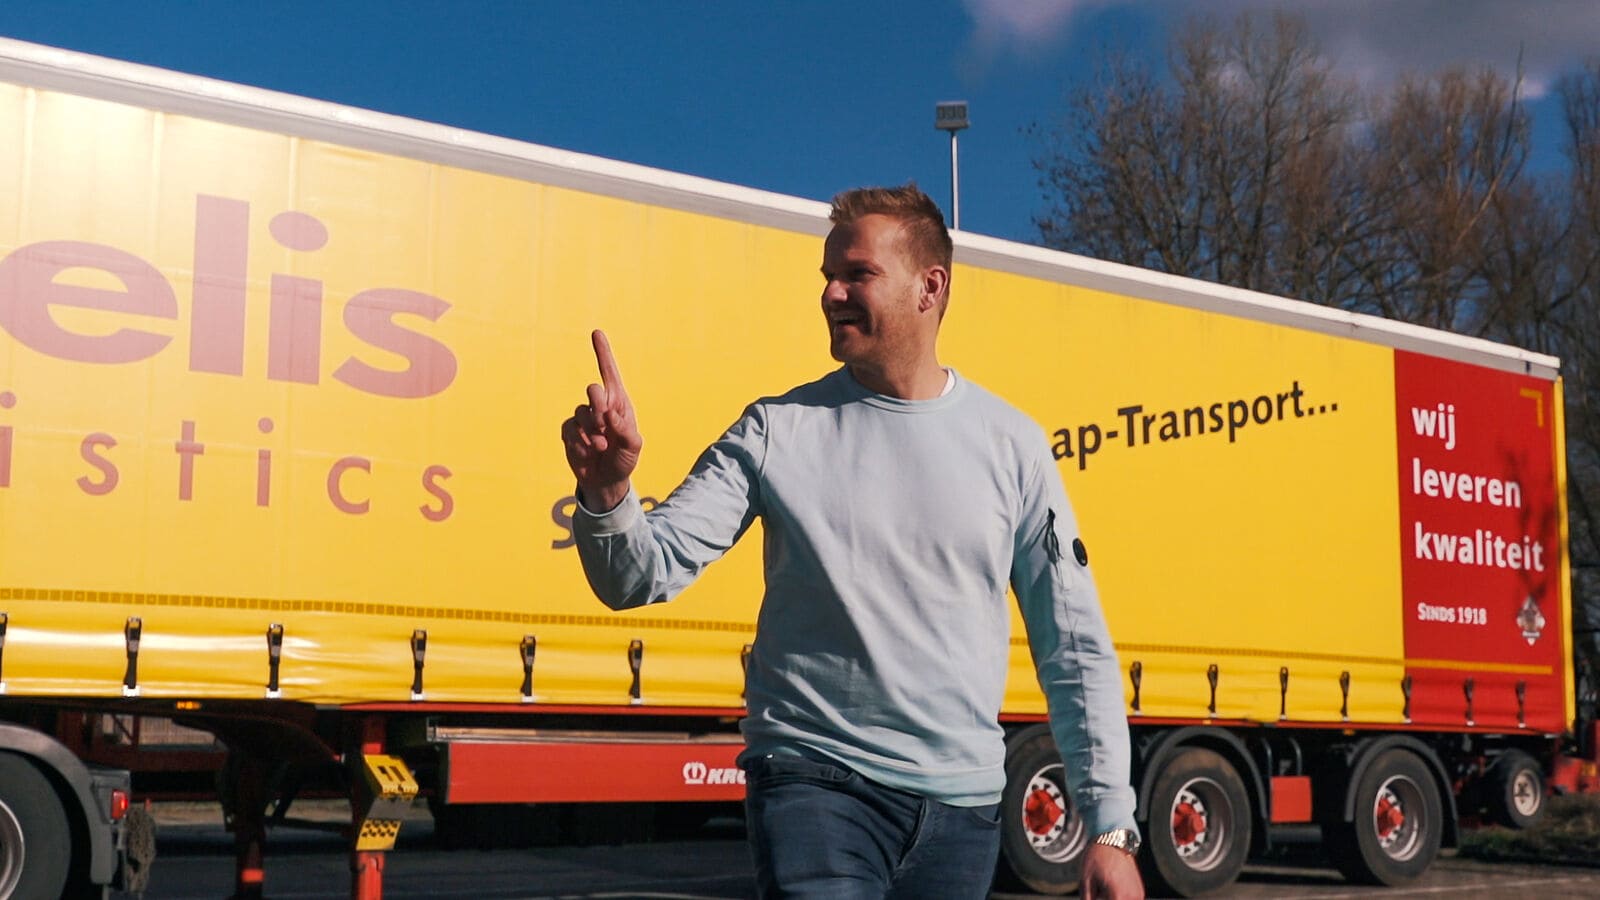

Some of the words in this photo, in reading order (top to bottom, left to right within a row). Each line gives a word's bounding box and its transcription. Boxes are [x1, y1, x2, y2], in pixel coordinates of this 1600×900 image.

[0, 194, 458, 399] elis
[1412, 403, 1456, 450] wij
[0, 391, 454, 522] istics
[1413, 457, 1521, 508] leveren
[1414, 521, 1544, 572] kwaliteit
[1458, 606, 1487, 625] 1918
